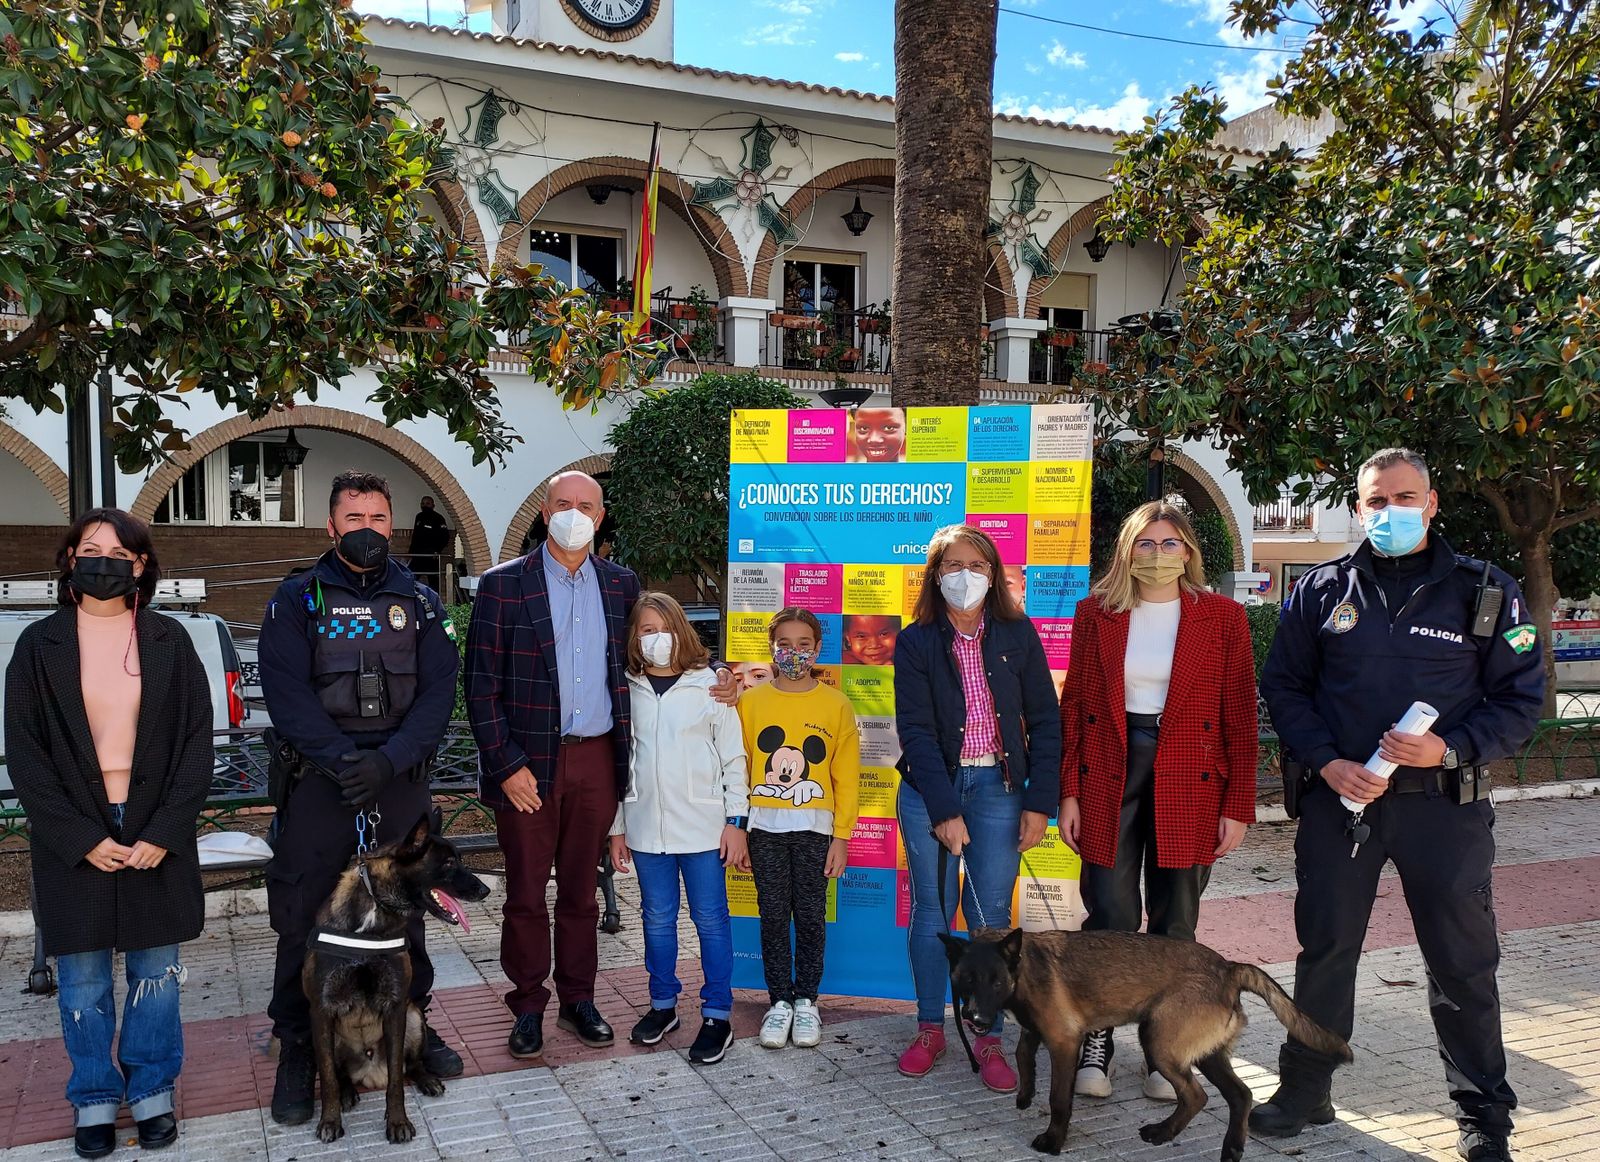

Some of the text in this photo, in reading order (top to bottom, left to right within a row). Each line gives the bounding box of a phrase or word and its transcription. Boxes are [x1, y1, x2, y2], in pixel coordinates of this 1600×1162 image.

[920, 416, 942, 425] INTERÉS
[982, 416, 1014, 424] APLICACIÓN
[1048, 413, 1082, 422] ORIENTACIÓN
[744, 420, 770, 428] DEFINICIÓN
[794, 426, 834, 435] DISCRIMINACIÓN
[982, 468, 1022, 476] SUPERVIVENCIA
[738, 482, 818, 510] ¿CONOCES
[824, 483, 854, 505] TUS
[860, 482, 953, 505] DERECHOS?
[764, 510, 932, 522] CONVENCIÓN SOBRE LOS DERECHOS DEL NIÑO
[980, 520, 1008, 528] IDENTIDAD
[1043, 518, 1078, 528] SEPARACIÓN
[1034, 528, 1060, 536] FAMILIAR
[892, 542, 929, 554] unice
[742, 568, 764, 576] REUNIÓN
[857, 569, 878, 578] OPINIÓN
[848, 578, 864, 586] NIÑOS
[870, 578, 886, 586] NIÑAS
[790, 584, 809, 592] ILÍCITAS
[1038, 588, 1076, 596] PENSAMIENTO
[332, 607, 372, 615] POLICIA
[856, 678, 880, 686] ADOPCIÓN
[862, 722, 890, 730] SEGURIDAD
[870, 823, 892, 832] FORMAS
[850, 830, 884, 840] EXPLOTACIÓN
[842, 880, 854, 888] MÁS
[1026, 884, 1060, 892] PROTOCOLOS
[1026, 892, 1063, 901] FACULTATIVOS
